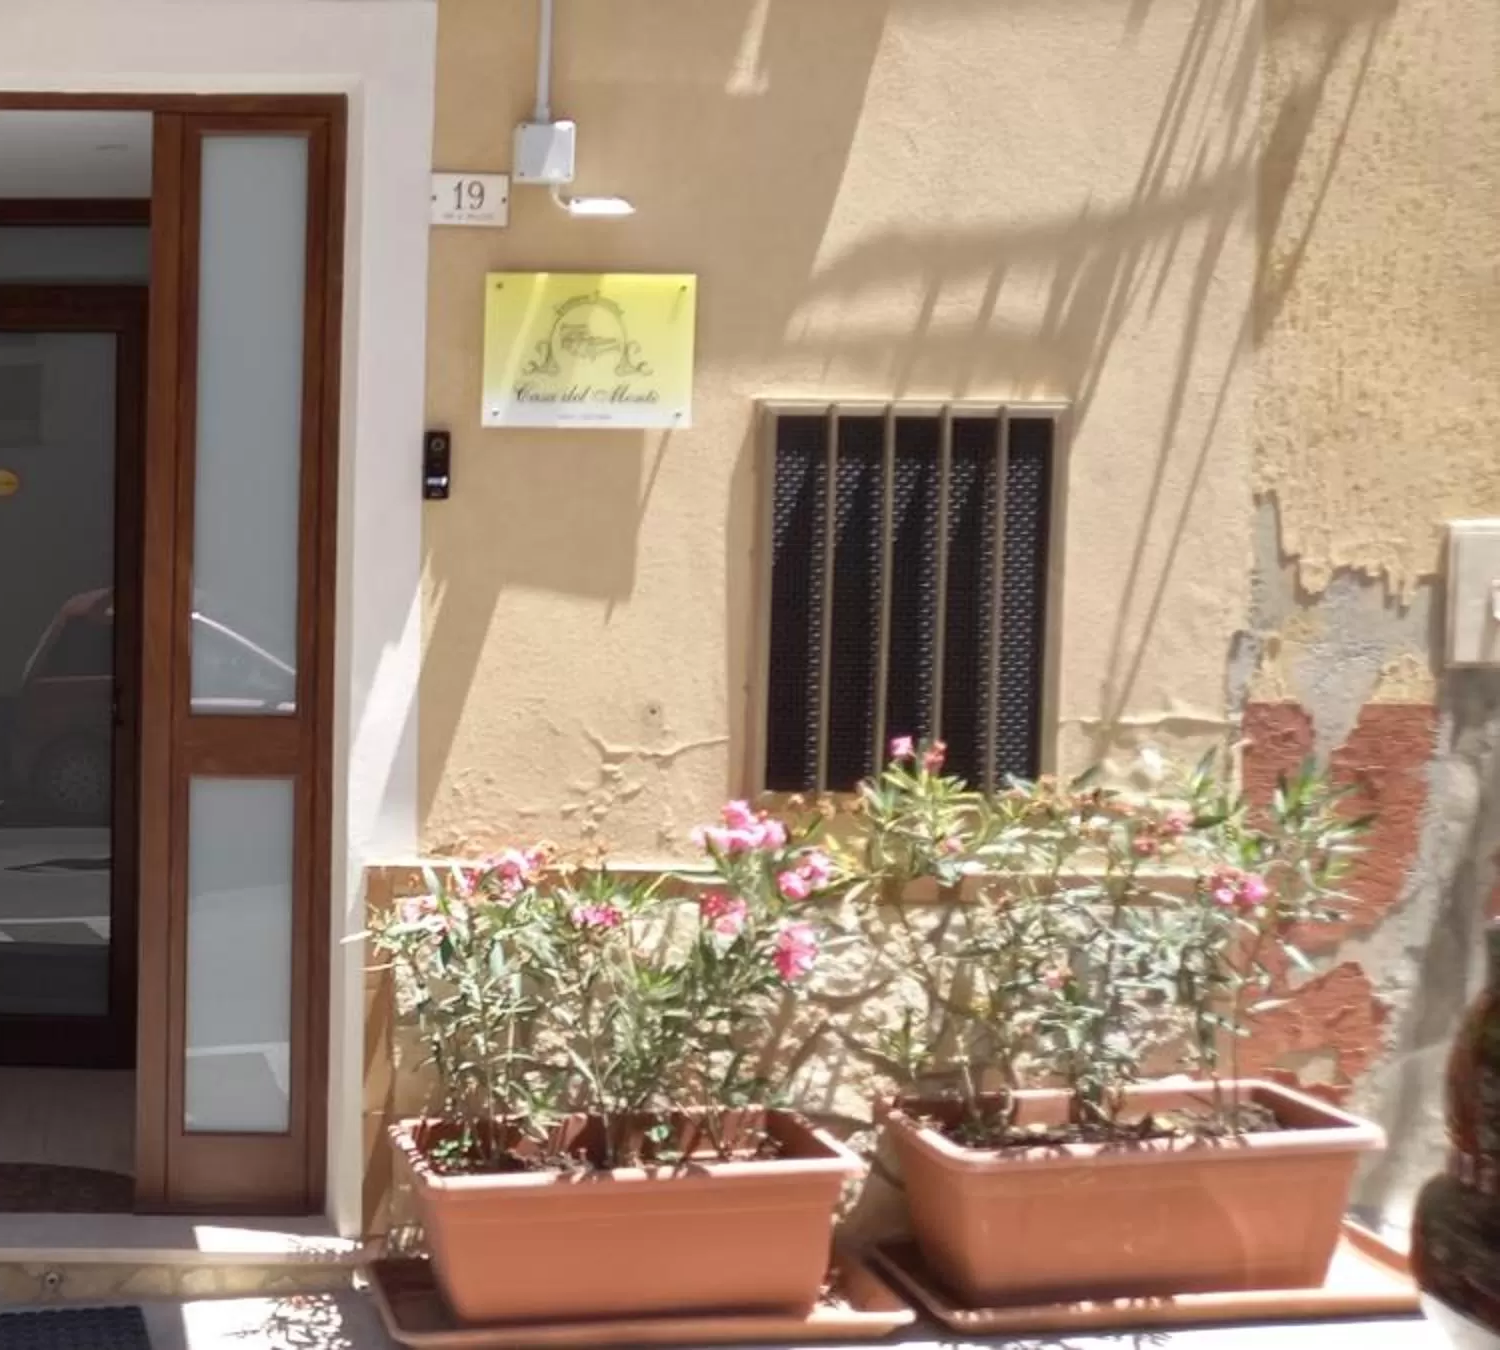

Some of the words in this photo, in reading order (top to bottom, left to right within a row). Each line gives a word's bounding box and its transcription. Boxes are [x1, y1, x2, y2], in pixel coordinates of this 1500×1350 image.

[453, 180, 486, 211] 19
[513, 383, 557, 404] Casa
[561, 383, 592, 404] del
